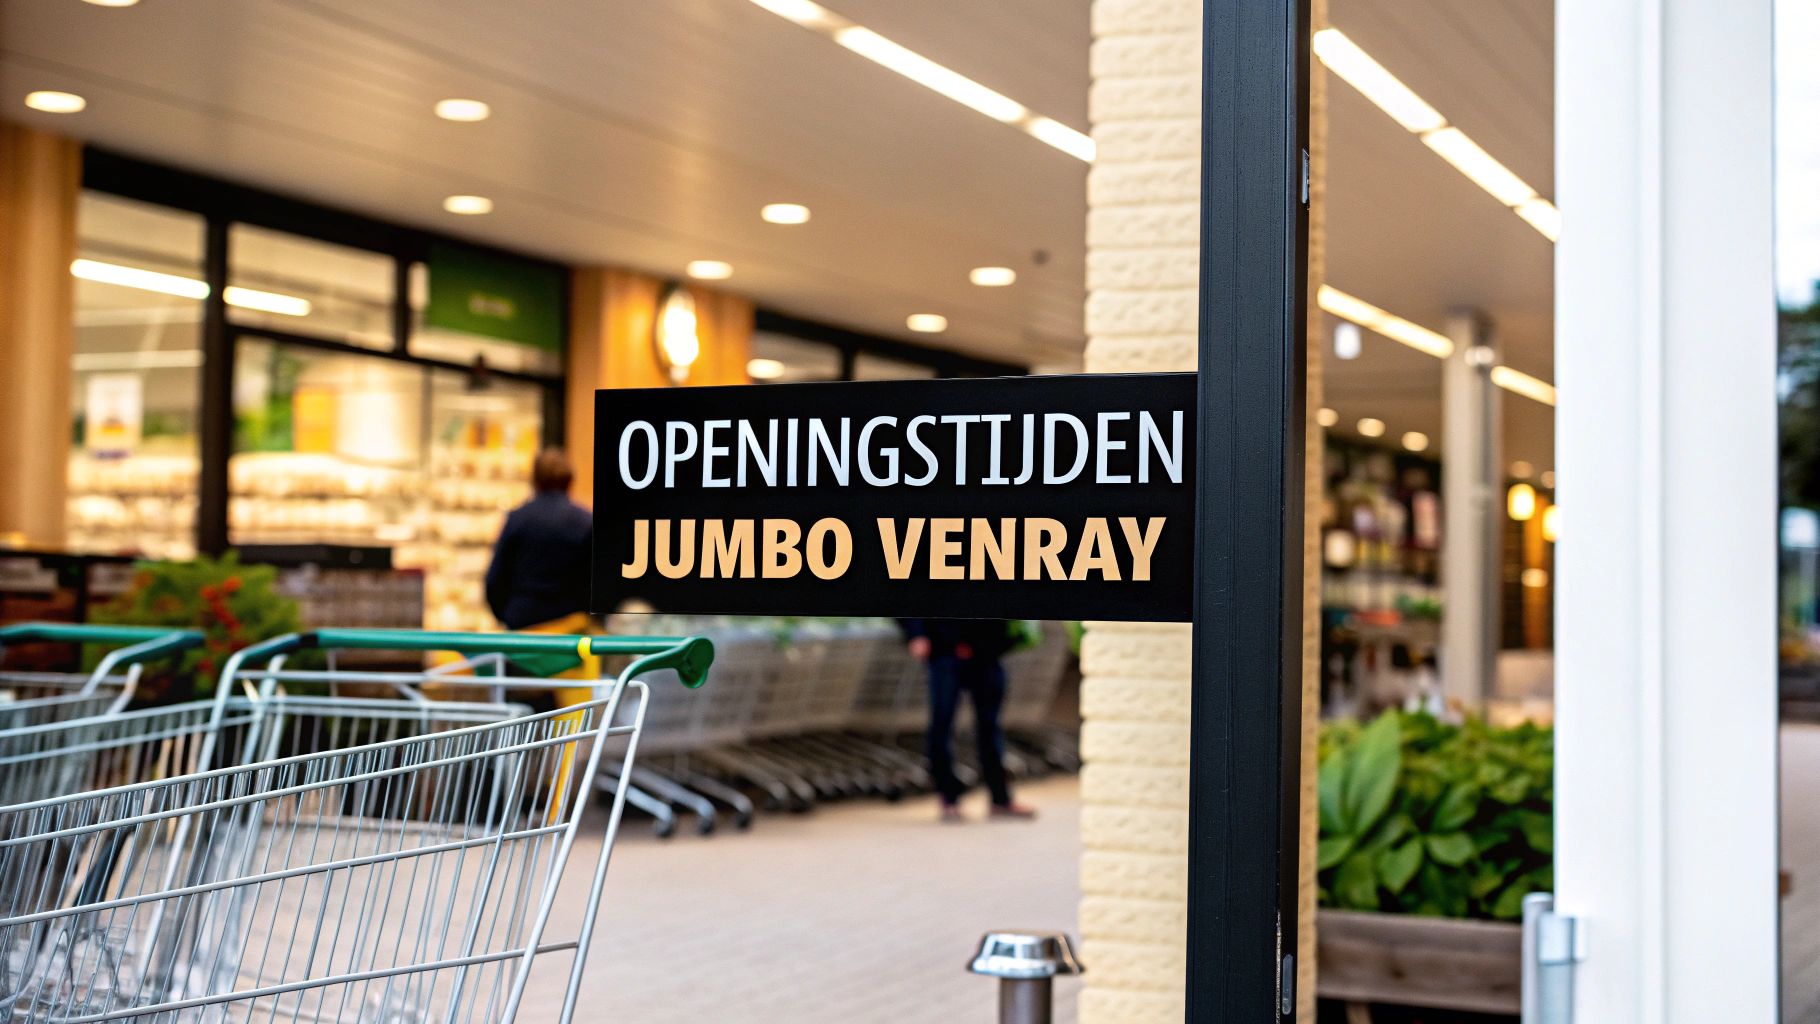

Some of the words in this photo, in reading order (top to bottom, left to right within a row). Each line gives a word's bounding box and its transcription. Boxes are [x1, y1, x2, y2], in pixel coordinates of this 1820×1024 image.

[619, 411, 1183, 489] OPENINGSTIJDEN
[622, 518, 852, 579] JUMBO
[877, 517, 1166, 580] VENRAY
